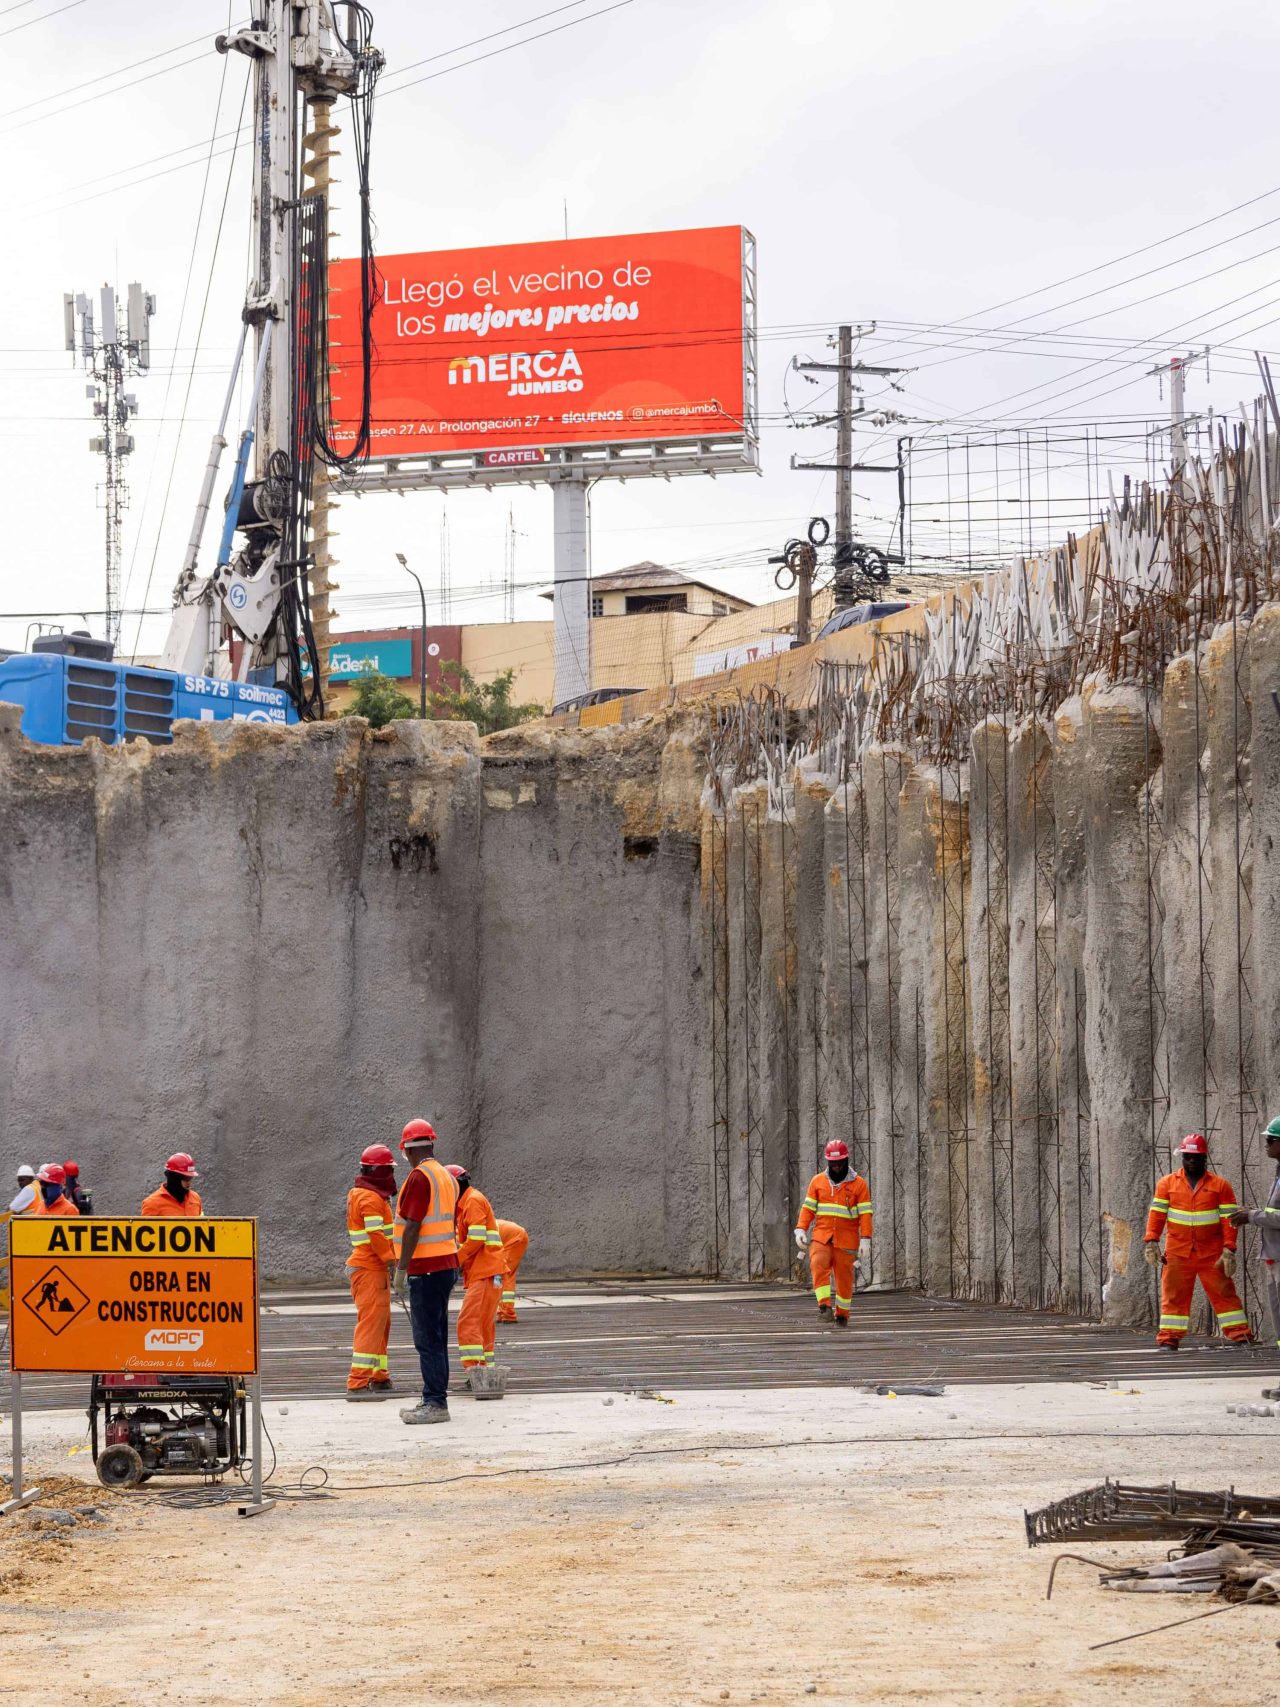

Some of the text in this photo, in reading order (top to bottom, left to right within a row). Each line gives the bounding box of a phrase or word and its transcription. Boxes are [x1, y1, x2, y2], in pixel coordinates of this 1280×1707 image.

[384, 261, 652, 307] Llegó el vecino de
[397, 295, 639, 337] los mejores precios
[507, 379, 584, 396] JUMBO
[368, 426, 397, 439] aseo
[439, 416, 522, 433] Prolongación
[524, 415, 540, 427] 27
[561, 409, 624, 425] SÍGUENOS
[645, 403, 718, 420] @mercajumbo
[488, 450, 539, 464] CARTEL
[184, 677, 283, 706] SR-75 soilmec
[268, 707, 286, 720] 4423
[47, 1225, 216, 1252] ATENCION
[129, 1270, 211, 1292] OBRA EN
[97, 1300, 244, 1323] CONSTRUCCION
[150, 1332, 201, 1345] MOPC
[175, 1355, 185, 1367] la
[192, 1357, 217, 1368] ente!
